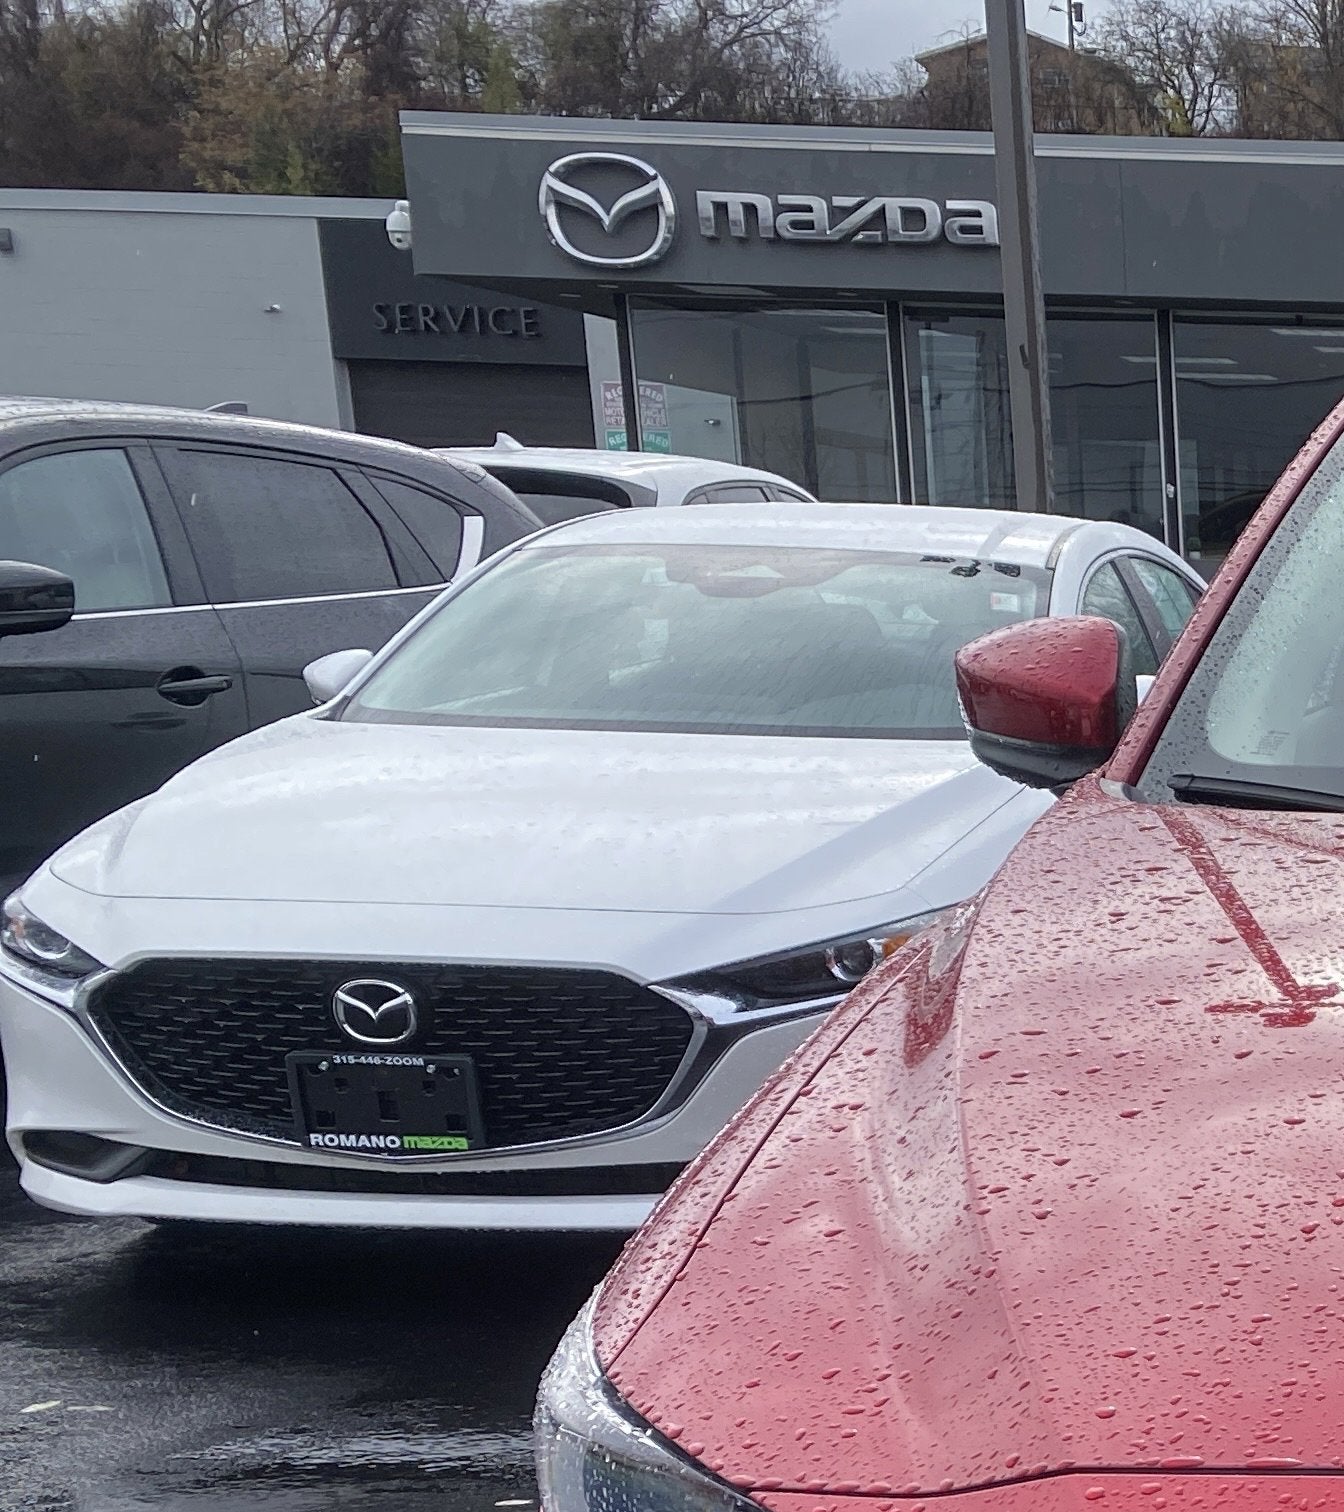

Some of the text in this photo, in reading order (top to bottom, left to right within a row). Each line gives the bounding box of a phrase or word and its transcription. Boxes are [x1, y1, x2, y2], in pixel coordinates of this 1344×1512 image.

[373, 302, 541, 337] SERVICE
[605, 386, 663, 402] REGERED
[309, 1133, 400, 1149] ROMANO
